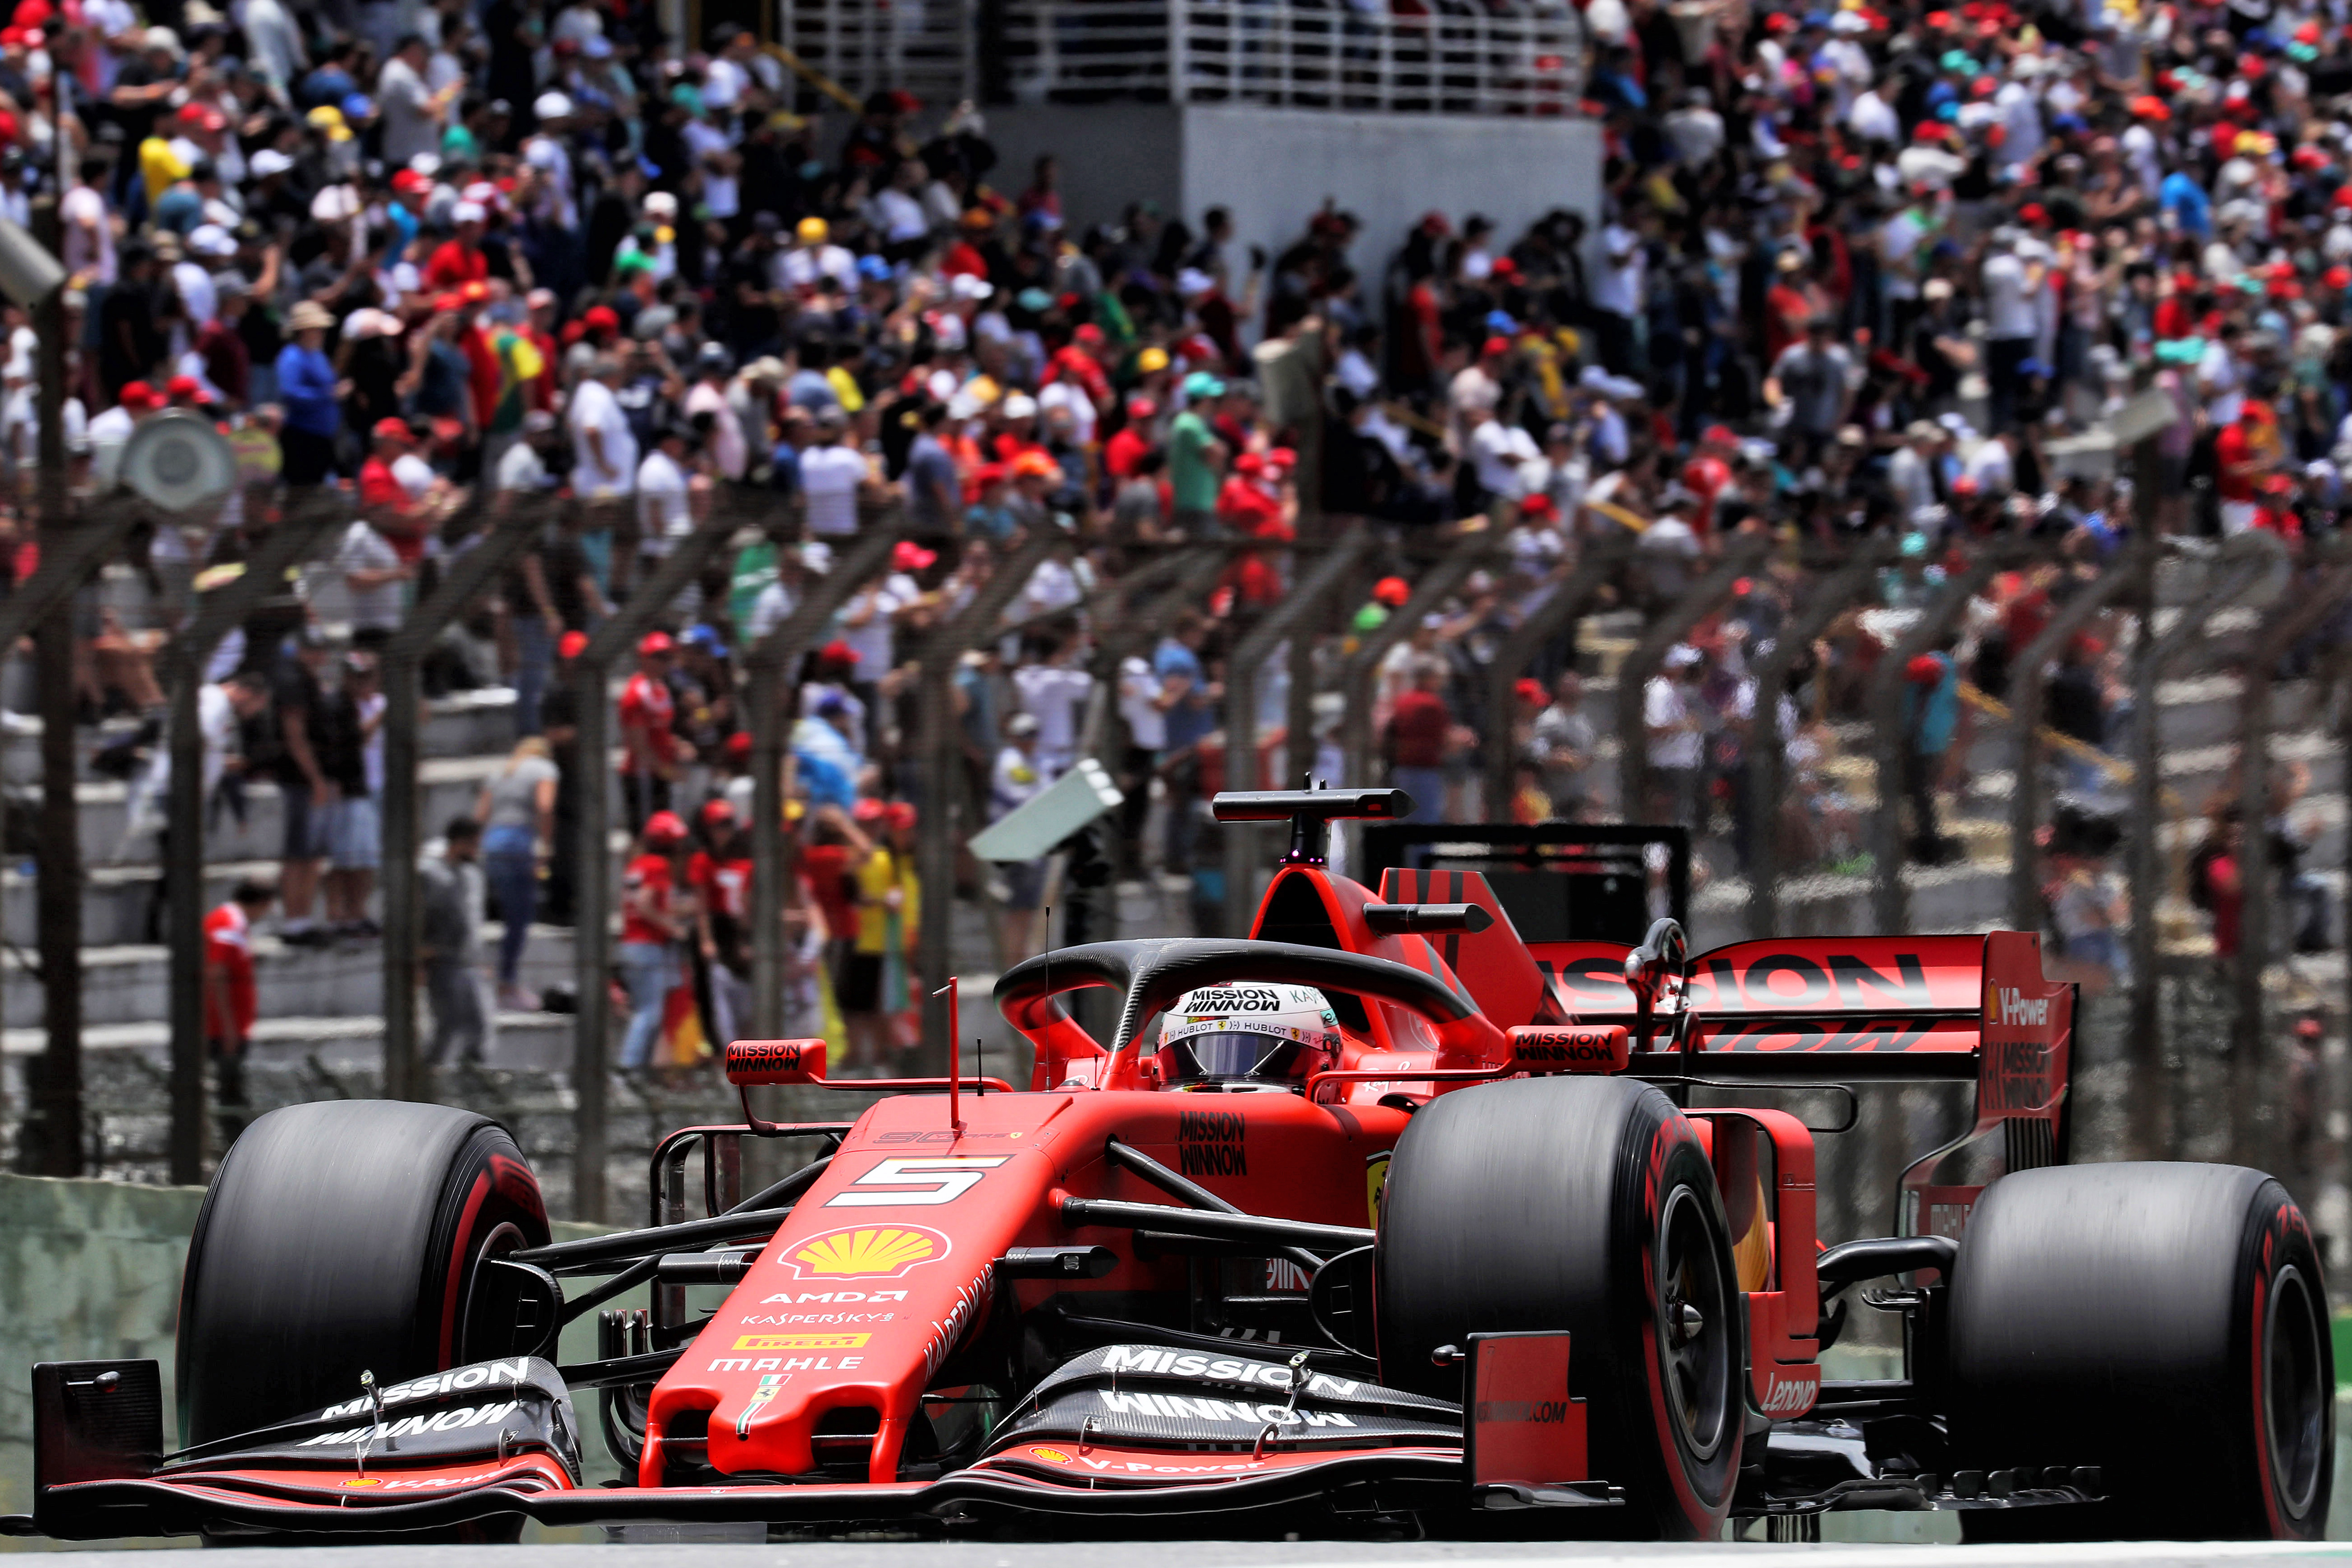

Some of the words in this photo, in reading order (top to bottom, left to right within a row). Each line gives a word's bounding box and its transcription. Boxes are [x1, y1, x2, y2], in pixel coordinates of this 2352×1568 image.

[1192, 989, 1279, 1001] MISSION
[1183, 1000, 1280, 1014] WINNOW
[2000, 988, 2049, 1026] V-Power
[1178, 1023, 1213, 1037] HUBLOT
[1244, 1022, 1287, 1035] HUBLOT
[1515, 1032, 1613, 1046] MISSION
[728, 1044, 801, 1057] MISSION
[1515, 1046, 1614, 1061] WINNOW
[727, 1057, 800, 1072] WINNOW
[1179, 1111, 1245, 1142] MISSION
[1178, 1144, 1247, 1176] WINNOW
[821, 1154, 1017, 1208] 5
[759, 1292, 867, 1304] AMD
[740, 1312, 882, 1326] KASPERSKY
[744, 1336, 859, 1347] PIRELLI
[706, 1357, 865, 1372] MAHLE
[1101, 1345, 1360, 1395] MISSION
[321, 1357, 530, 1419] MISSION
[1760, 1372, 1816, 1411] Lenovo
[1097, 1388, 1358, 1427] WINNOW
[296, 1399, 518, 1446] WINNOW
[1078, 1456, 1265, 1473] V-Power
